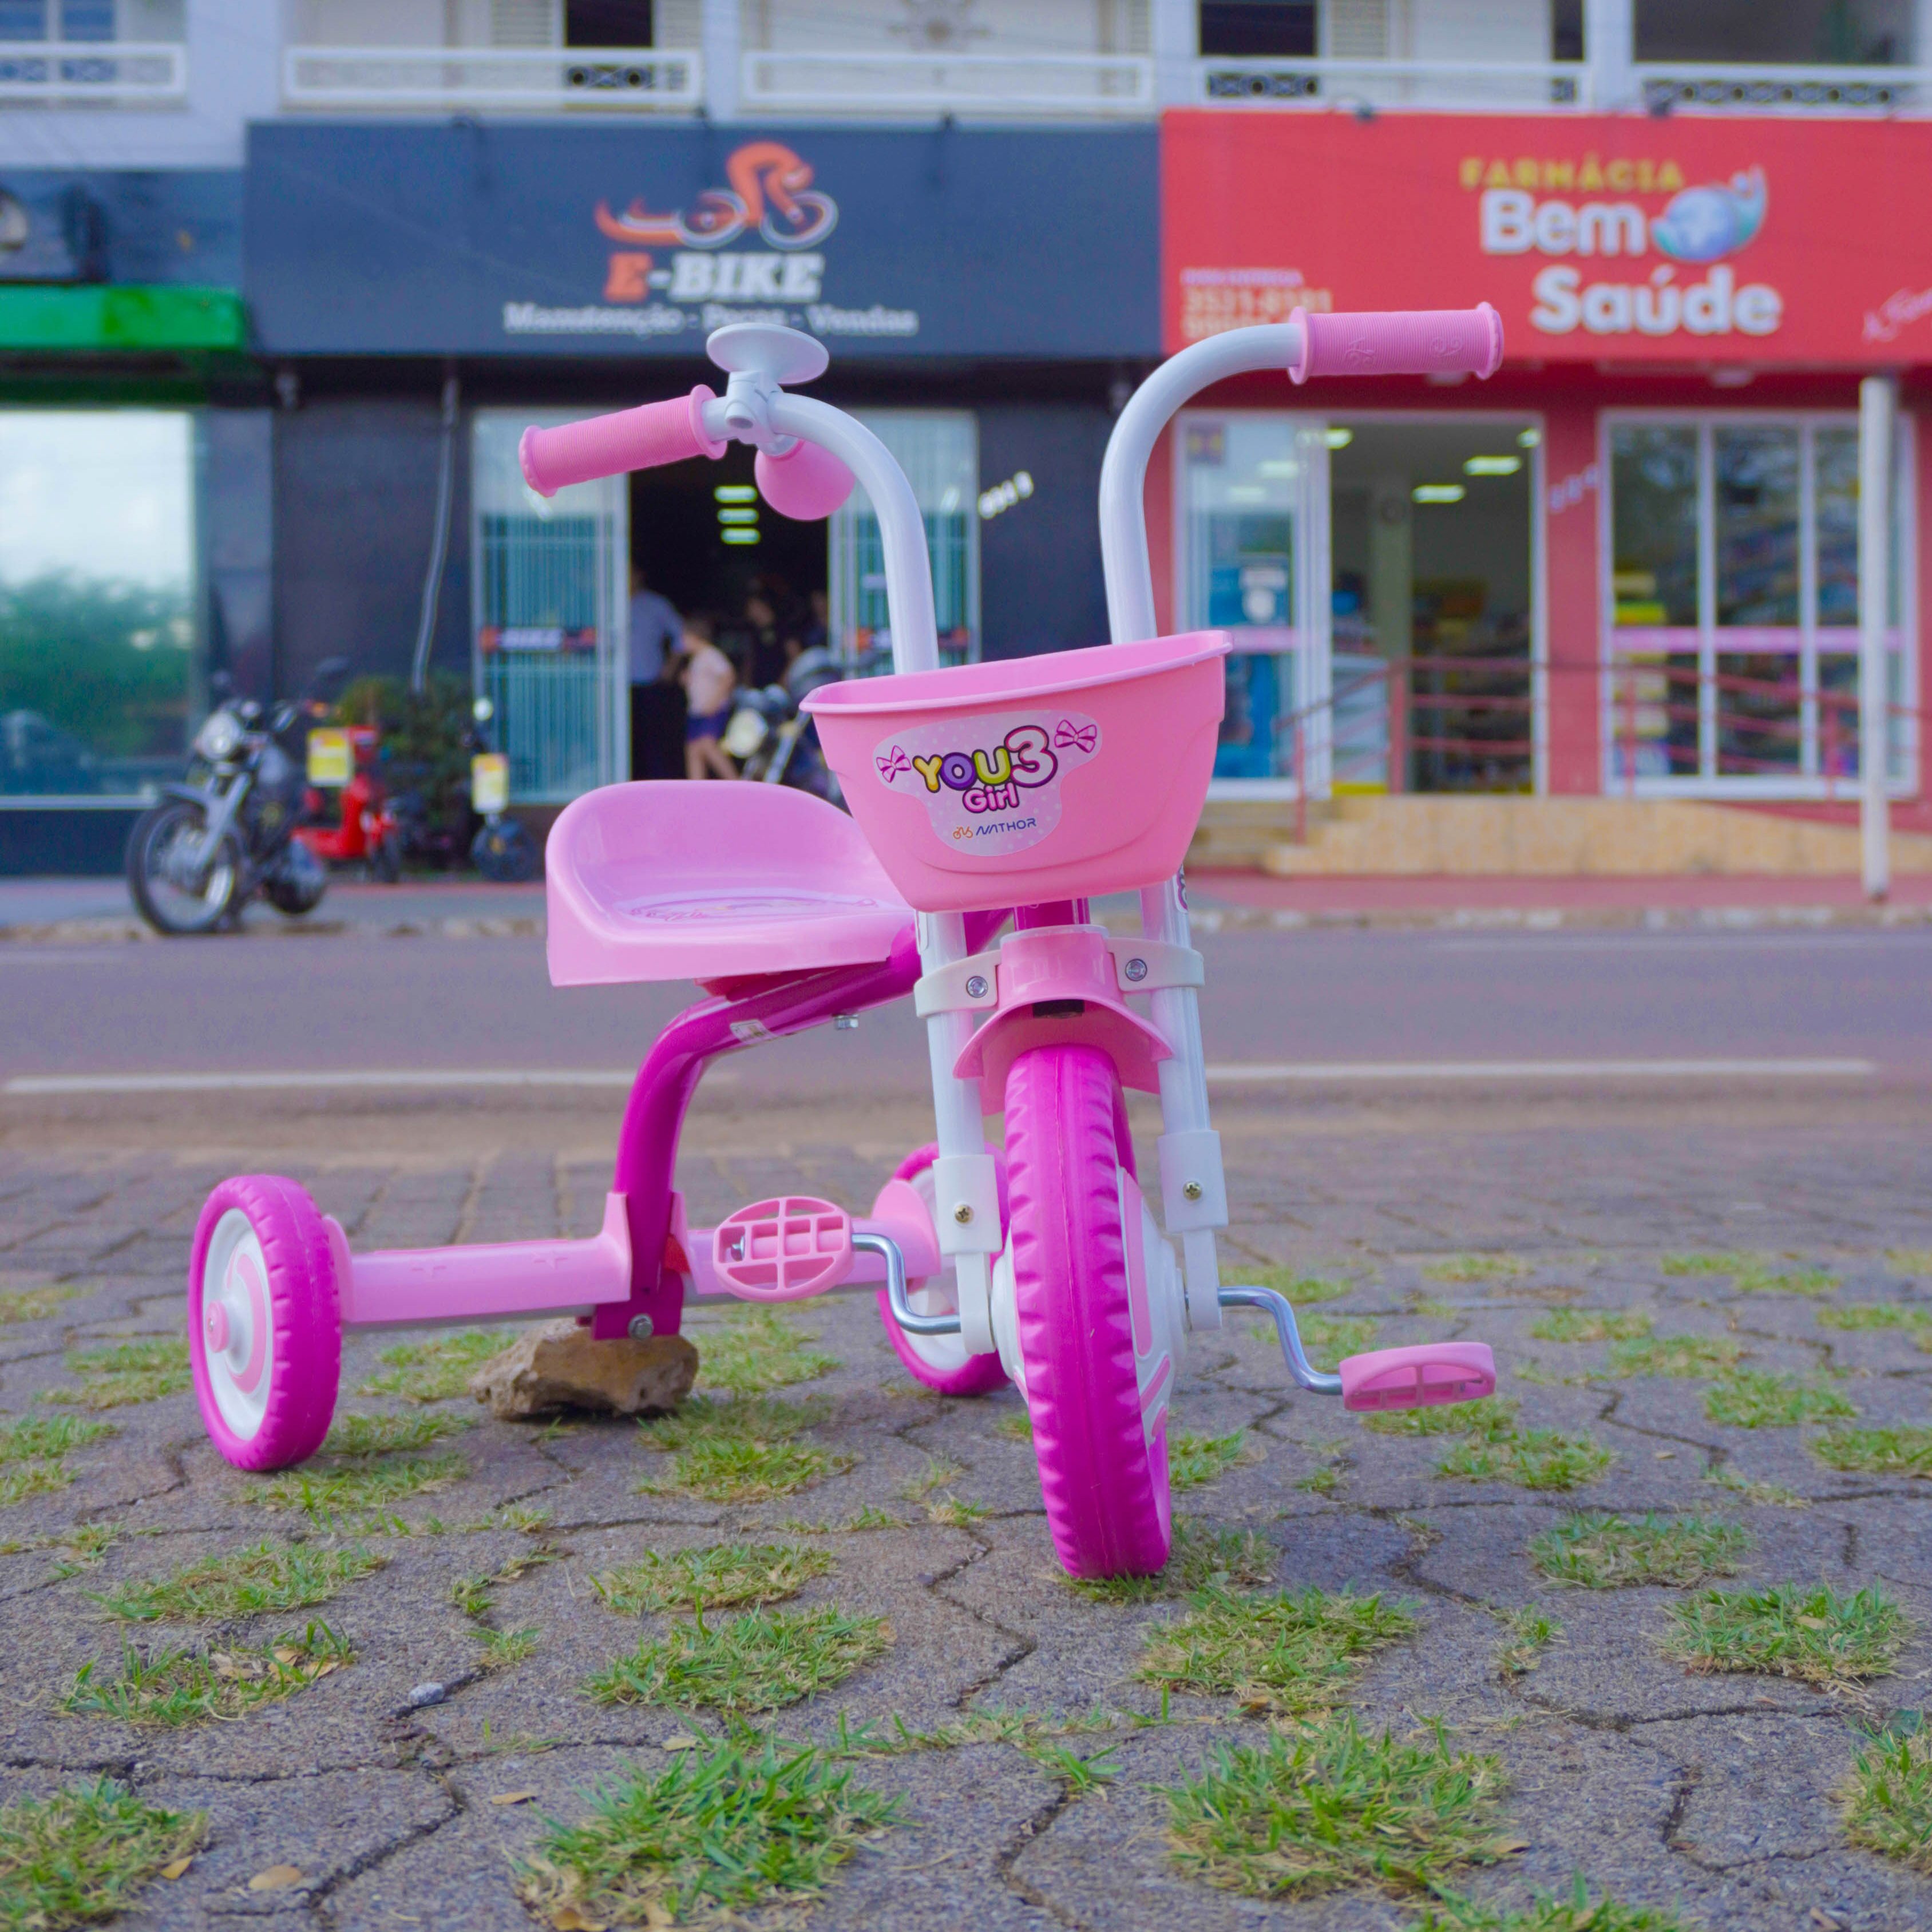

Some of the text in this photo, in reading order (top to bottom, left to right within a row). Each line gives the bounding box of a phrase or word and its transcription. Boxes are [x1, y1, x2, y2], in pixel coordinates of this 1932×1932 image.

[1460, 154, 1684, 191] FARMÁCIA
[1480, 188, 1648, 255] Bem
[603, 252, 825, 303] E-BIKE
[1530, 264, 1784, 335] Saúde
[504, 303, 686, 339] Manutenção
[806, 303, 919, 336] Vendas
[963, 781, 1020, 814] Girl
[976, 817, 1037, 836] NATHOR
